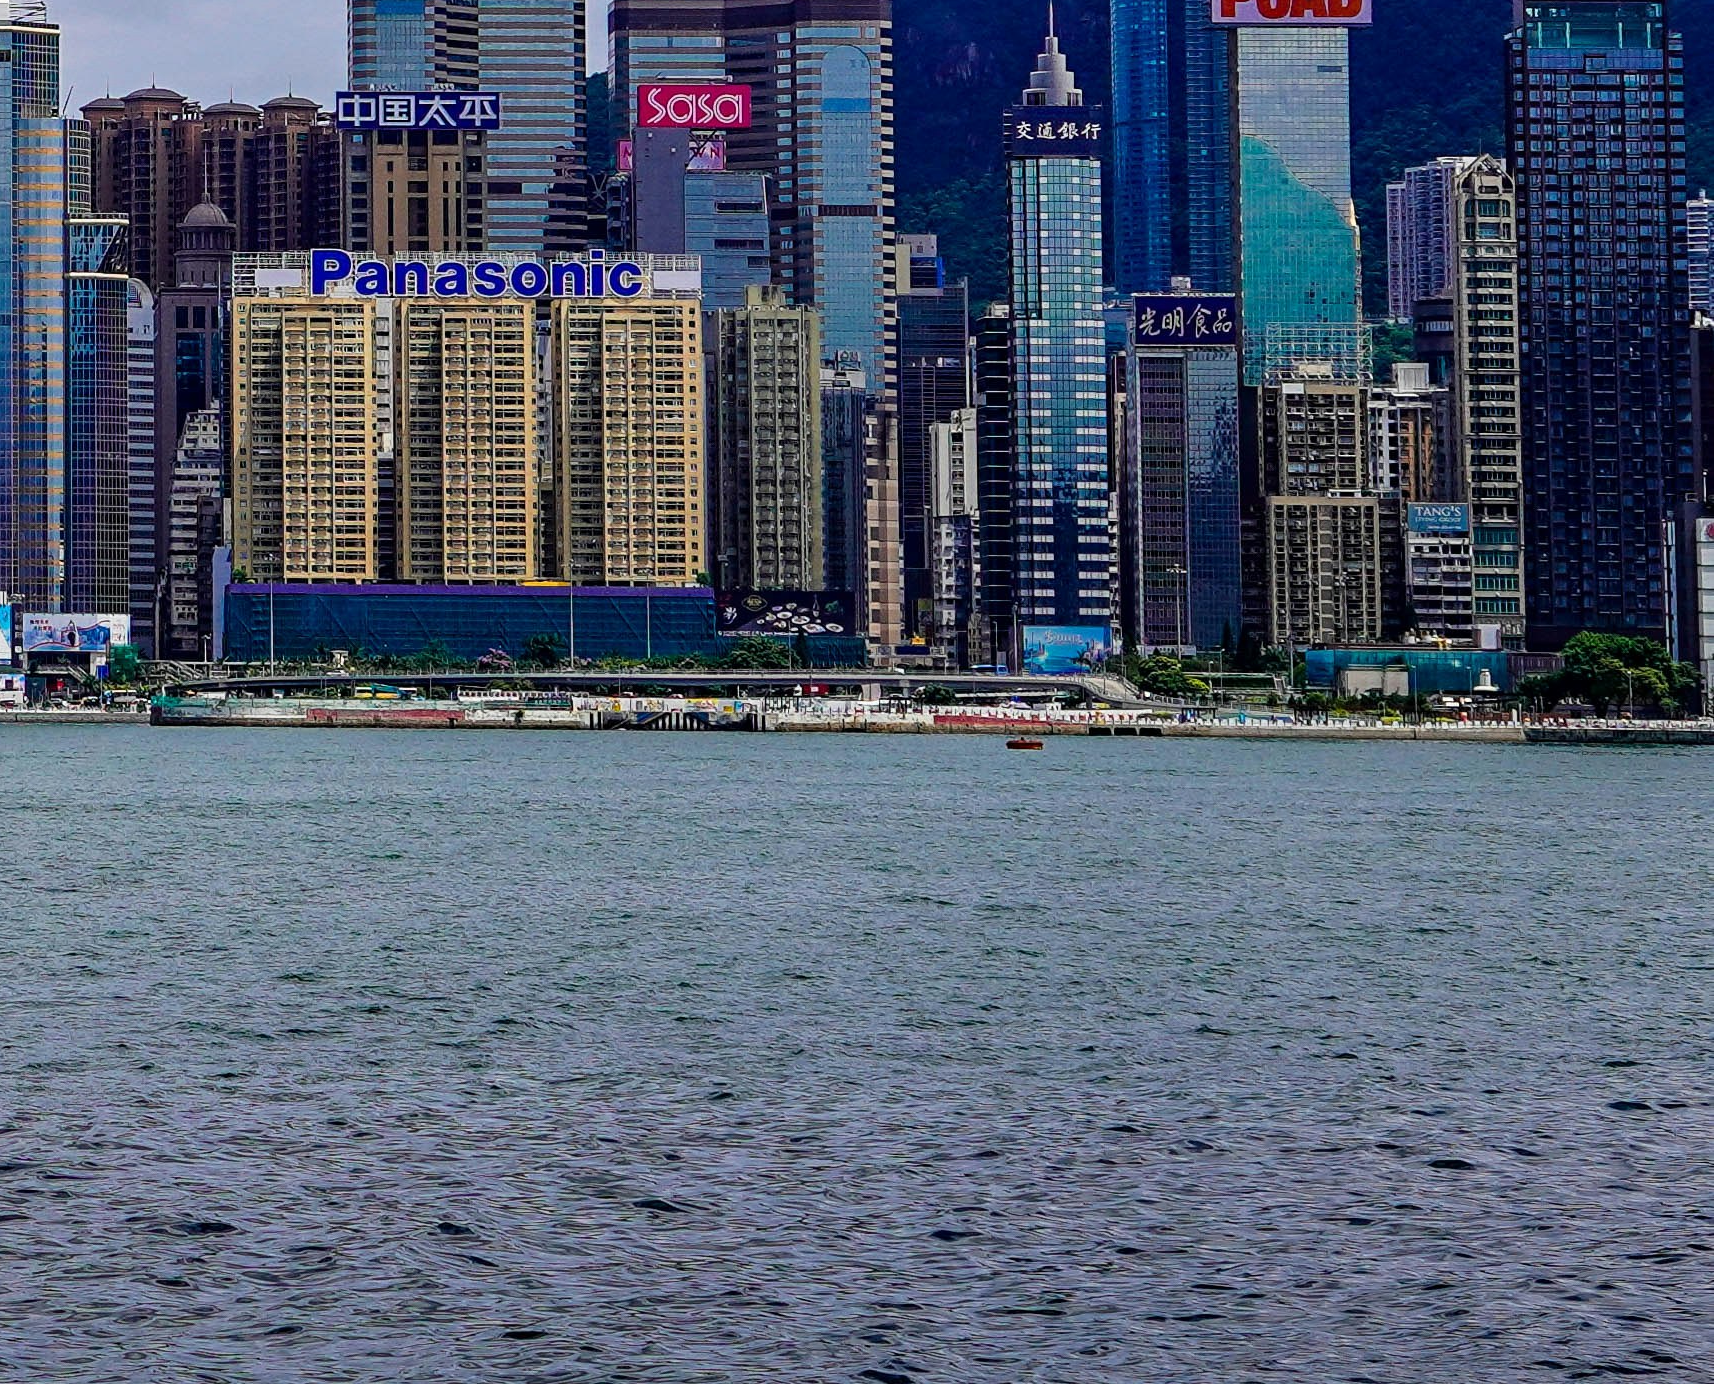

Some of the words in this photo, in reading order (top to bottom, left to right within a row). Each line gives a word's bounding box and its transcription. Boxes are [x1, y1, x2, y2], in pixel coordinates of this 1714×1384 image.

[338, 94, 498, 127] 中国太平
[1015, 120, 1102, 140] 交通銀行
[310, 248, 644, 297] Panasonic
[1138, 303, 1233, 339] 光明食品
[1414, 505, 1462, 517] TANG'S
